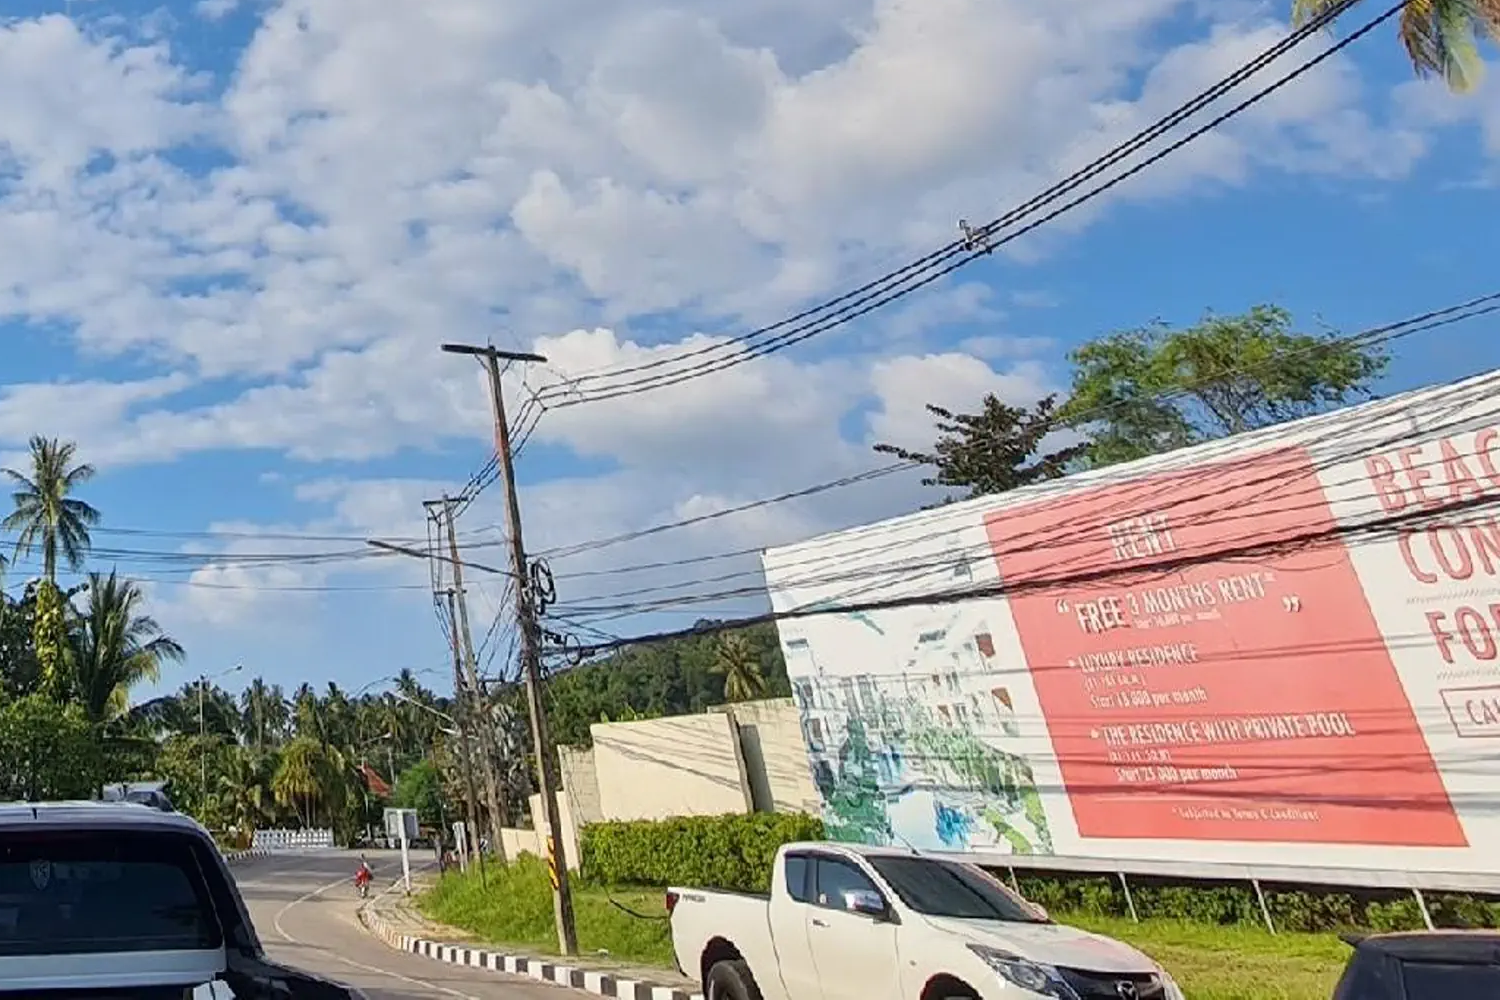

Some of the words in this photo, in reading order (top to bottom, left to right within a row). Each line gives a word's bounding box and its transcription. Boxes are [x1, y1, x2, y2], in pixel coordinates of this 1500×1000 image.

[1075, 597, 1127, 633] FREE
[1143, 583, 1216, 615] MONTHS
[1102, 725, 1129, 746] THE
[1130, 720, 1199, 744] RESIDENCE
[1243, 715, 1304, 739] PRIVATE
[1306, 713, 1355, 736] POOL
